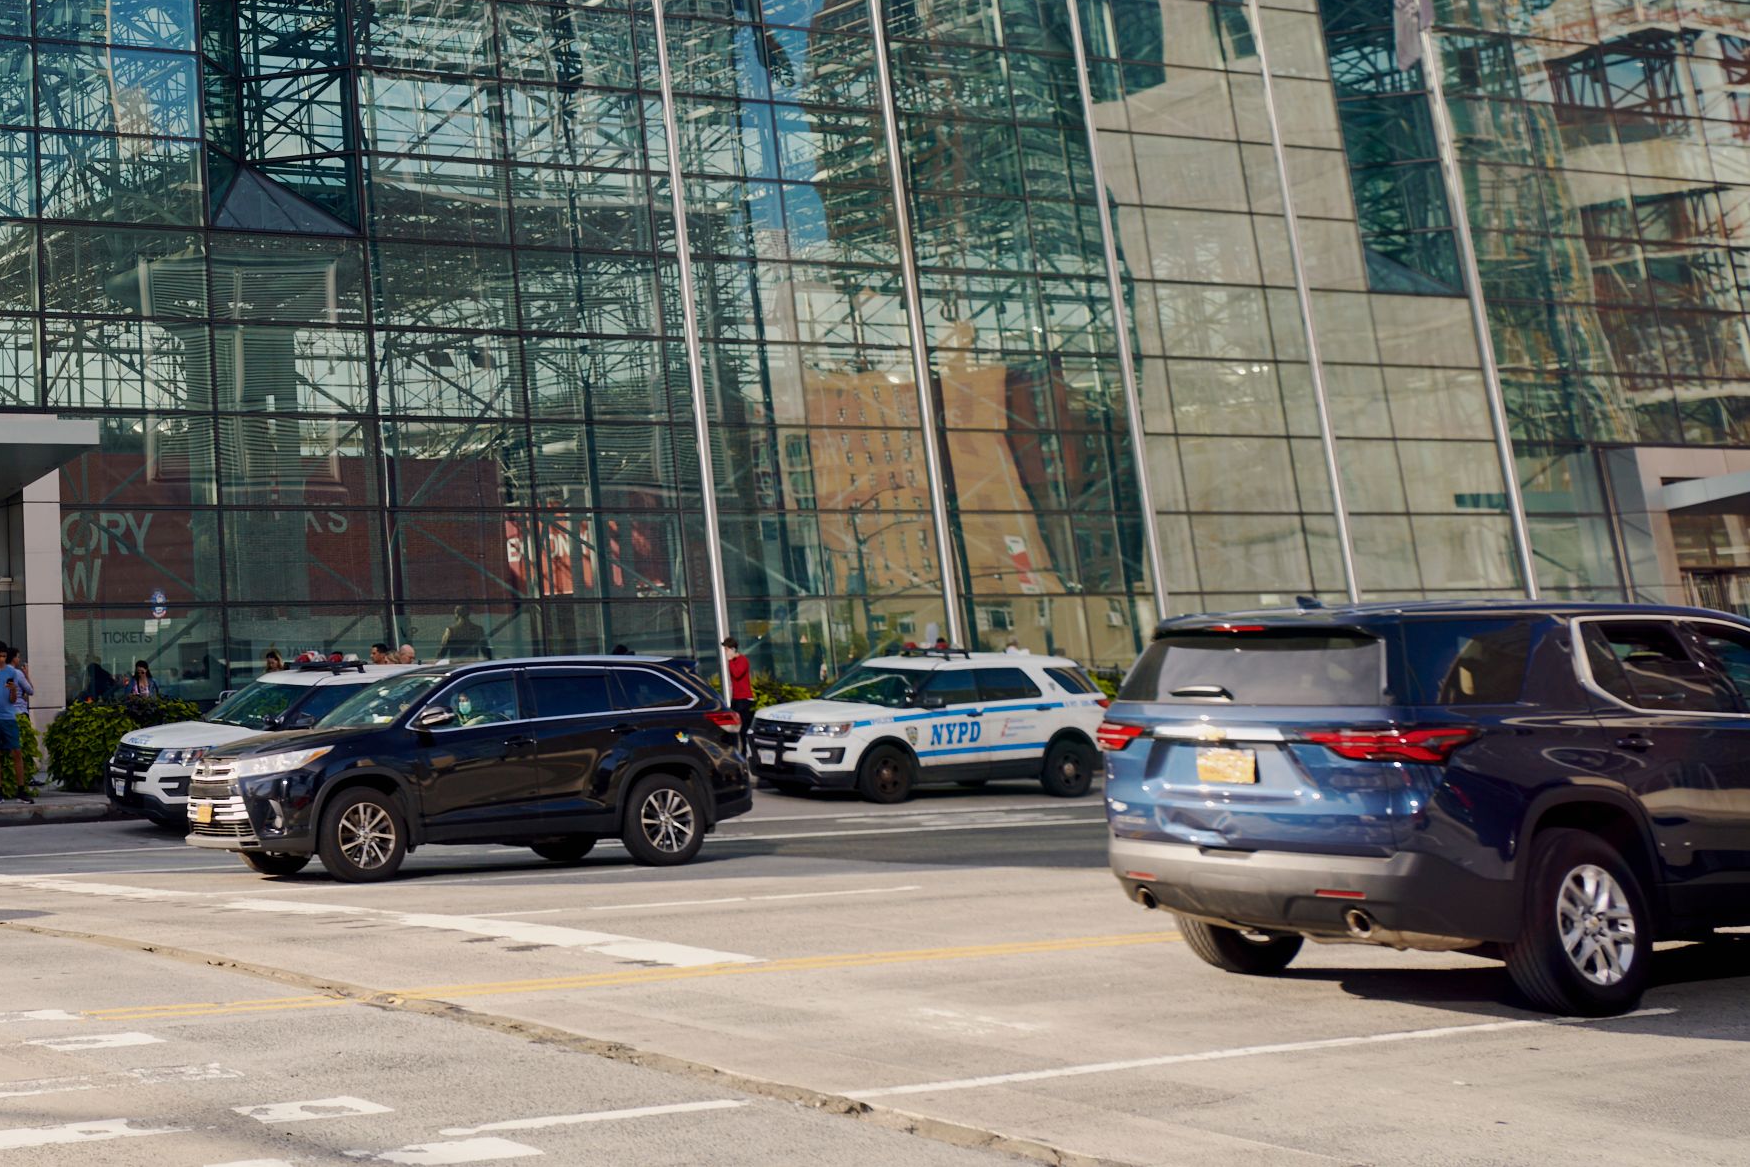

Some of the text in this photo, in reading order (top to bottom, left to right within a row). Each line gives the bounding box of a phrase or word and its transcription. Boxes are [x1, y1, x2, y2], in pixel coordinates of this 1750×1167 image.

[61, 512, 154, 556] ORY
[102, 631, 153, 644] TICKETS
[930, 720, 982, 747] NYPD
